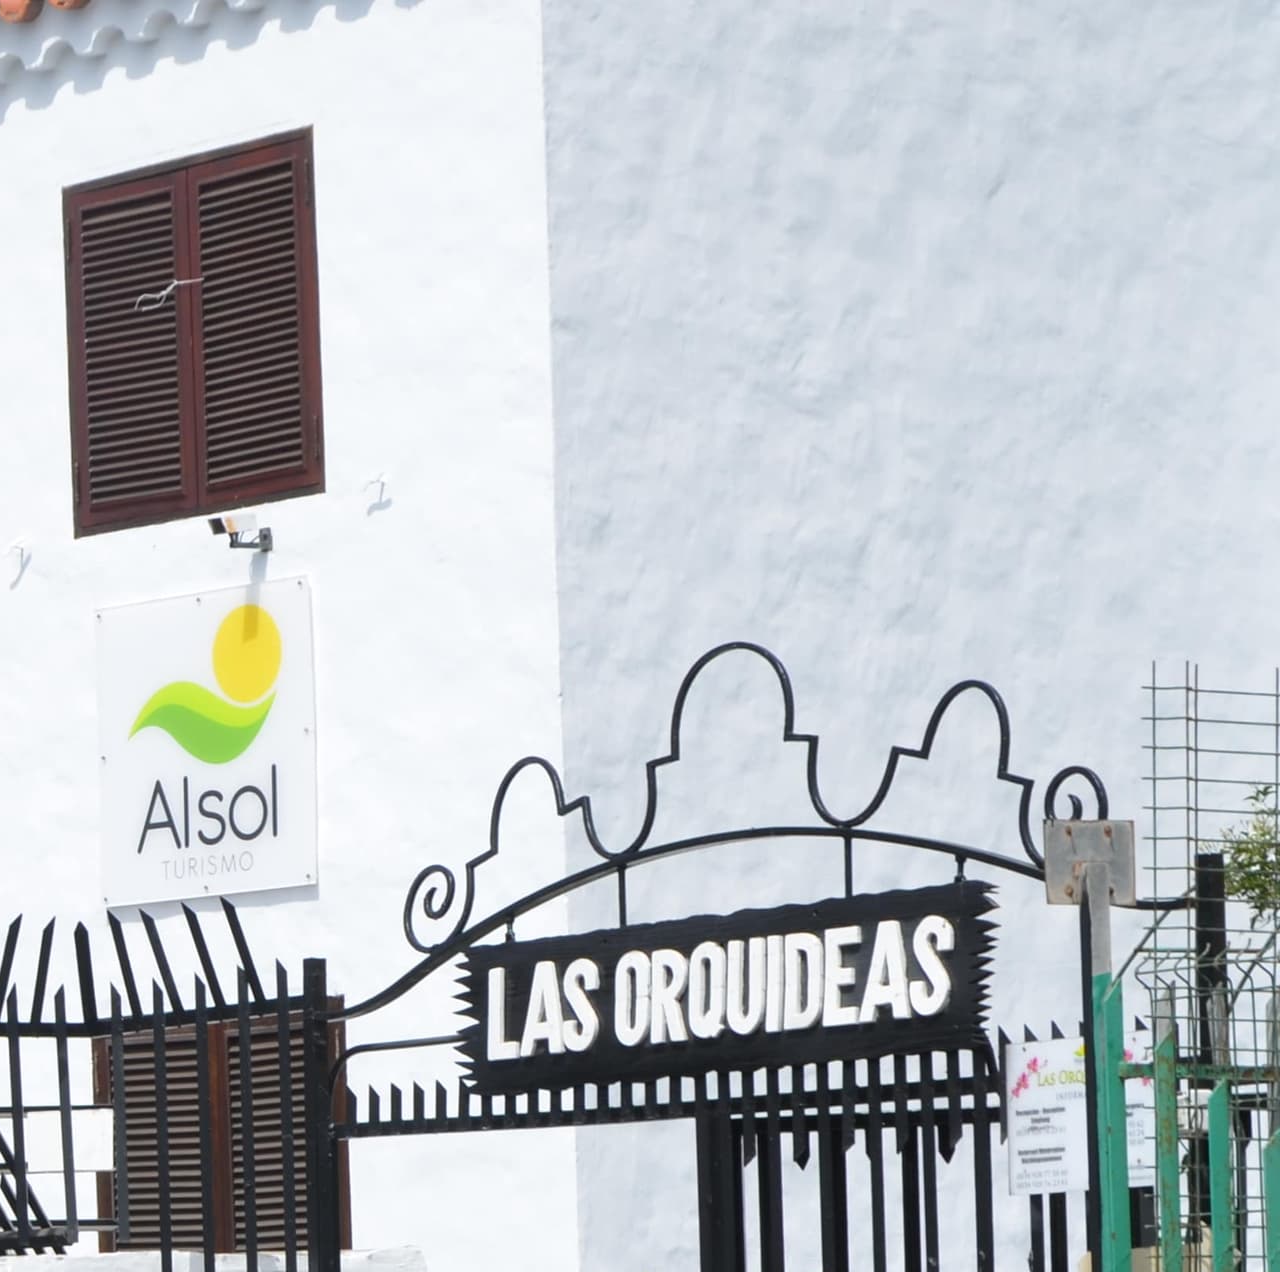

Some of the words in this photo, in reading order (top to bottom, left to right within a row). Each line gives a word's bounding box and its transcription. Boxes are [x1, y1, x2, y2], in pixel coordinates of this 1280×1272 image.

[137, 763, 278, 854] Alsol
[161, 851, 254, 880] TURISMO
[486, 957, 600, 1062] LAS
[614, 914, 956, 1049] ORQUIDEAS
